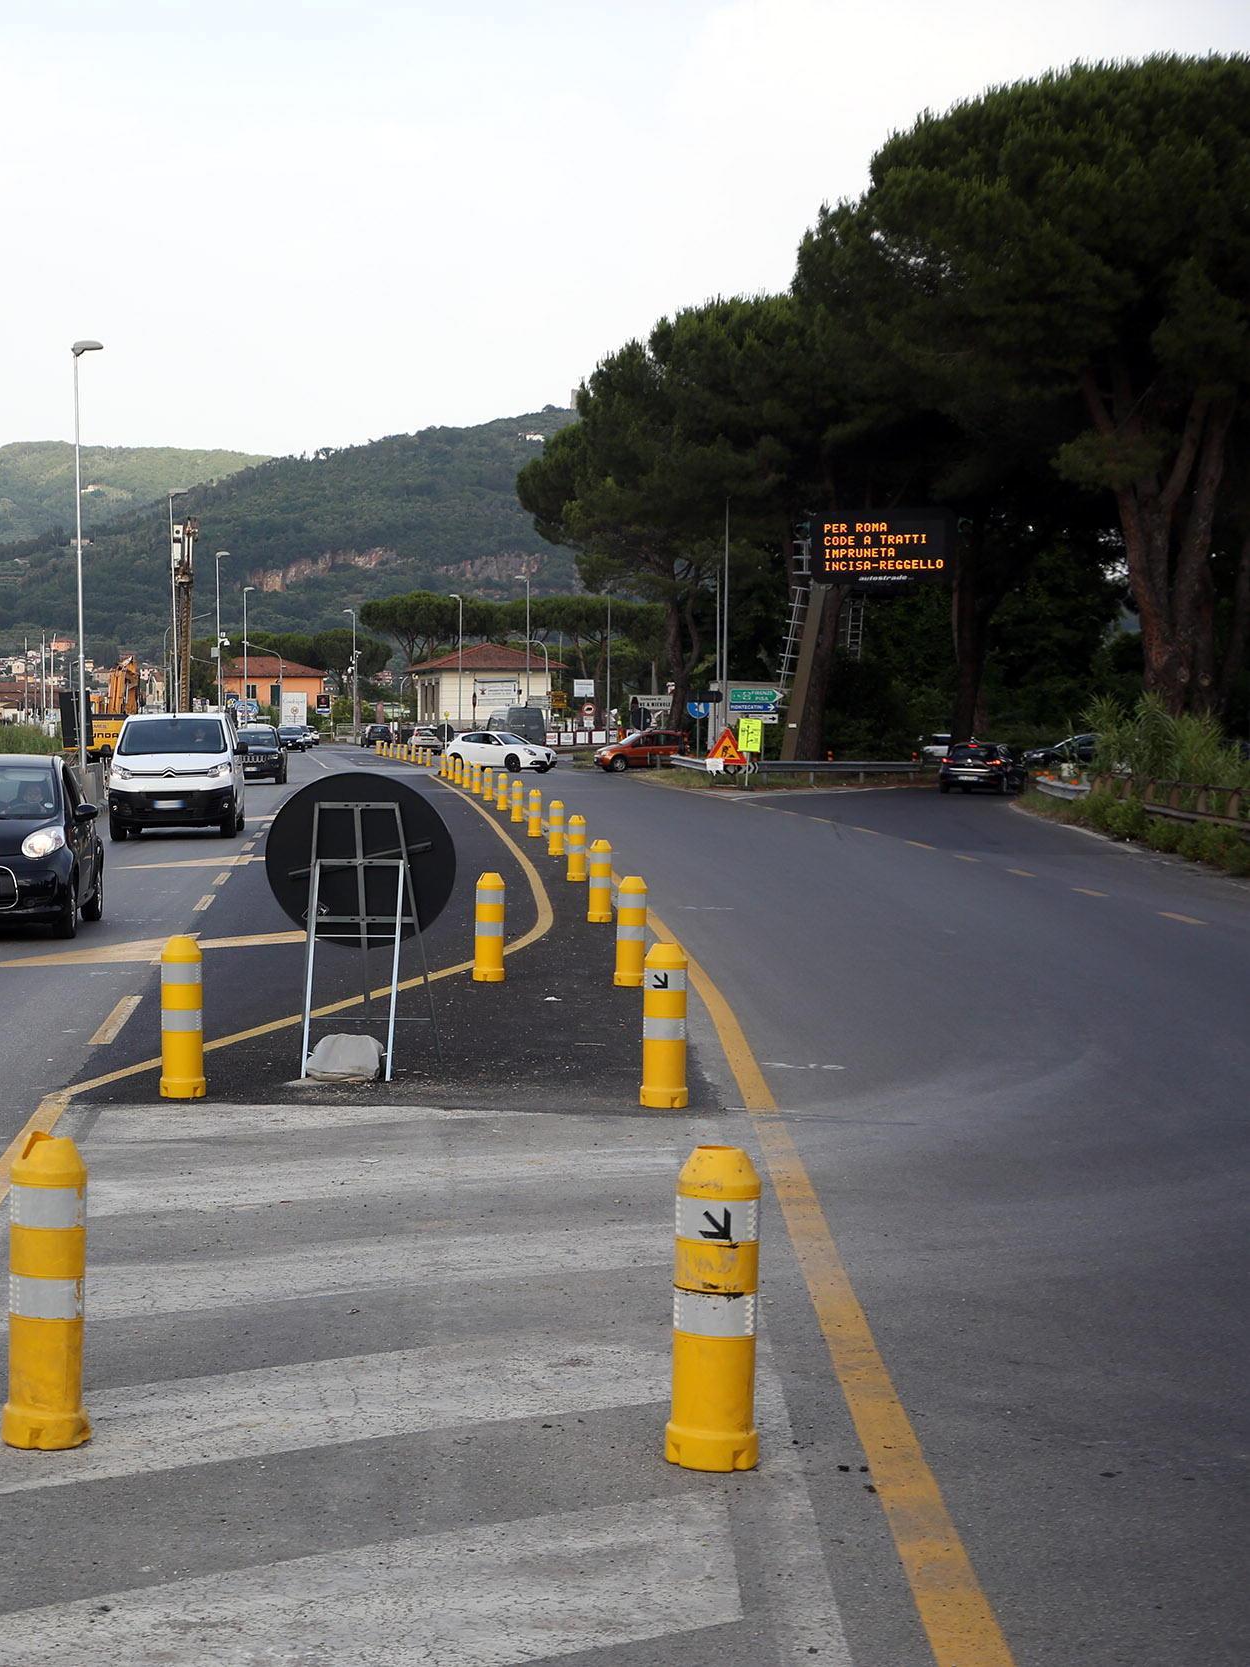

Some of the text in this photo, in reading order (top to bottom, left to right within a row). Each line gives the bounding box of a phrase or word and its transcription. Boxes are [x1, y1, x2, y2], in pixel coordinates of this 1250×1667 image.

[824, 522, 888, 533] PER ROMA
[823, 534, 927, 546] CODE A TRATTI
[824, 548, 895, 558] IMPRUNETA
[824, 559, 945, 571] INCISA-REGGELLO
